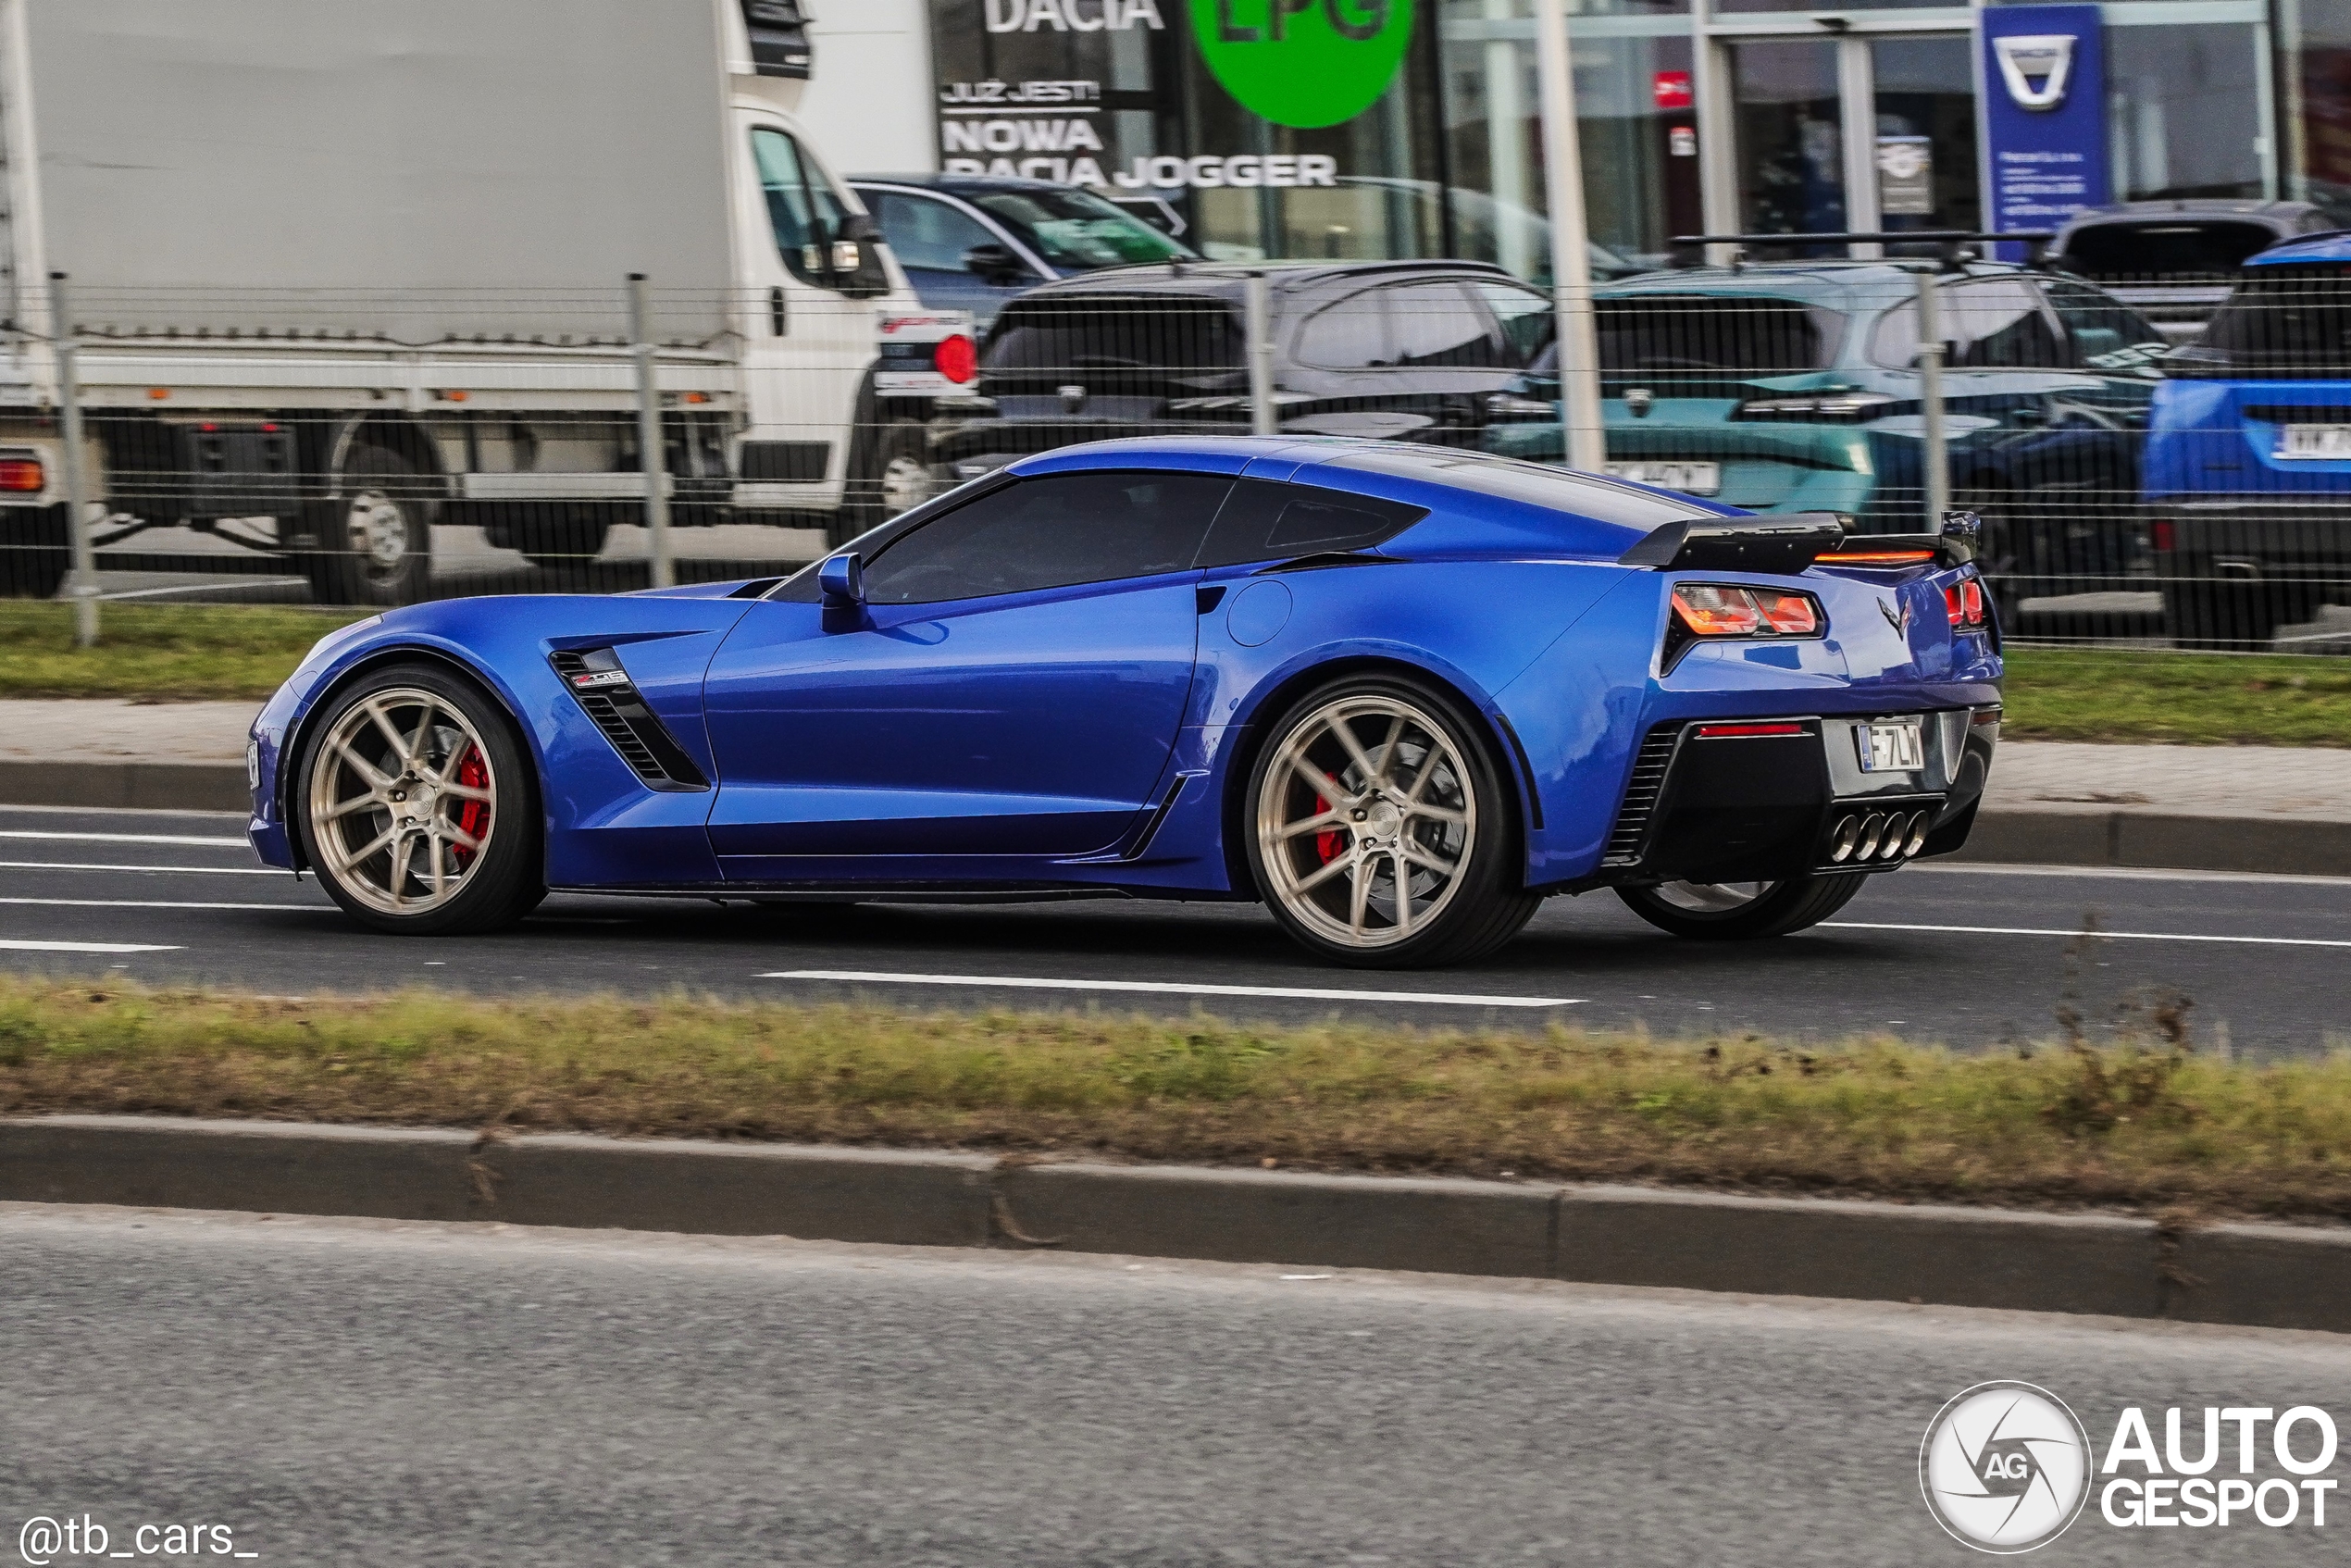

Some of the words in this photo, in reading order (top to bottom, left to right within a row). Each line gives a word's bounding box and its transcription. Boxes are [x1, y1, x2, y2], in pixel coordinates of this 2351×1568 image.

[985, 0, 1165, 32] DACIA
[1216, 0, 1392, 42] LPG
[941, 119, 1103, 152] NOWA
[1113, 156, 1337, 188] JOGGER
